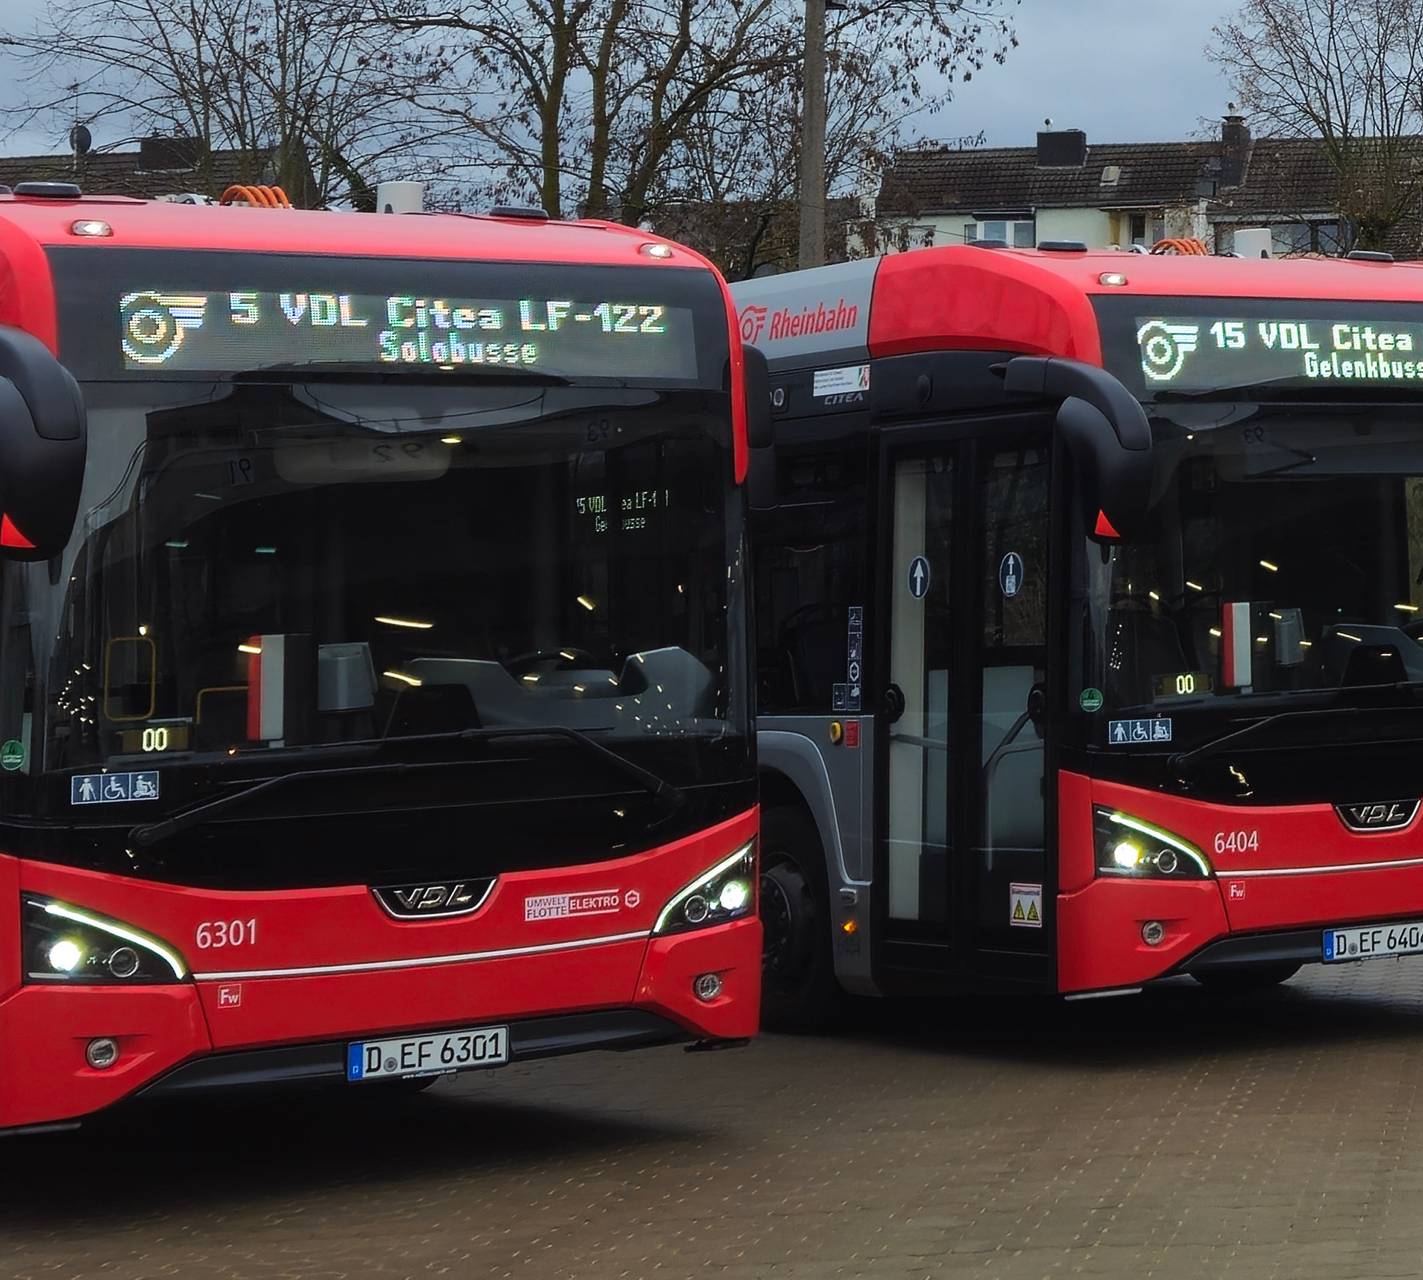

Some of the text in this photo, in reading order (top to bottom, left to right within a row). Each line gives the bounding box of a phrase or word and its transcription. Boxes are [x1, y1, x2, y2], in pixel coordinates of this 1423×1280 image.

[229, 292, 665, 333] 5 VDL Citea LF-122
[768, 298, 858, 341] Rheinbahn
[379, 330, 538, 364] Solobusse
[1209, 321, 1245, 348] 15
[1258, 322, 1319, 350] VDL
[1331, 324, 1413, 351] Citea
[824, 392, 864, 405] CITEA
[1176, 674, 1194, 694] 00
[142, 727, 168, 752] 00
[1350, 804, 1405, 824] VDL
[1214, 830, 1259, 854] 6404
[393, 884, 473, 910] VDL
[527, 896, 568, 909] UMWELT
[569, 895, 620, 912] ELEKTRO
[527, 906, 568, 920] FLOTTE
[195, 918, 256, 949] 6301
[1335, 934, 1347, 956] D
[1360, 930, 1382, 953] EF
[220, 988, 239, 1004] Fw
[365, 1032, 502, 1073] D EF 6301
